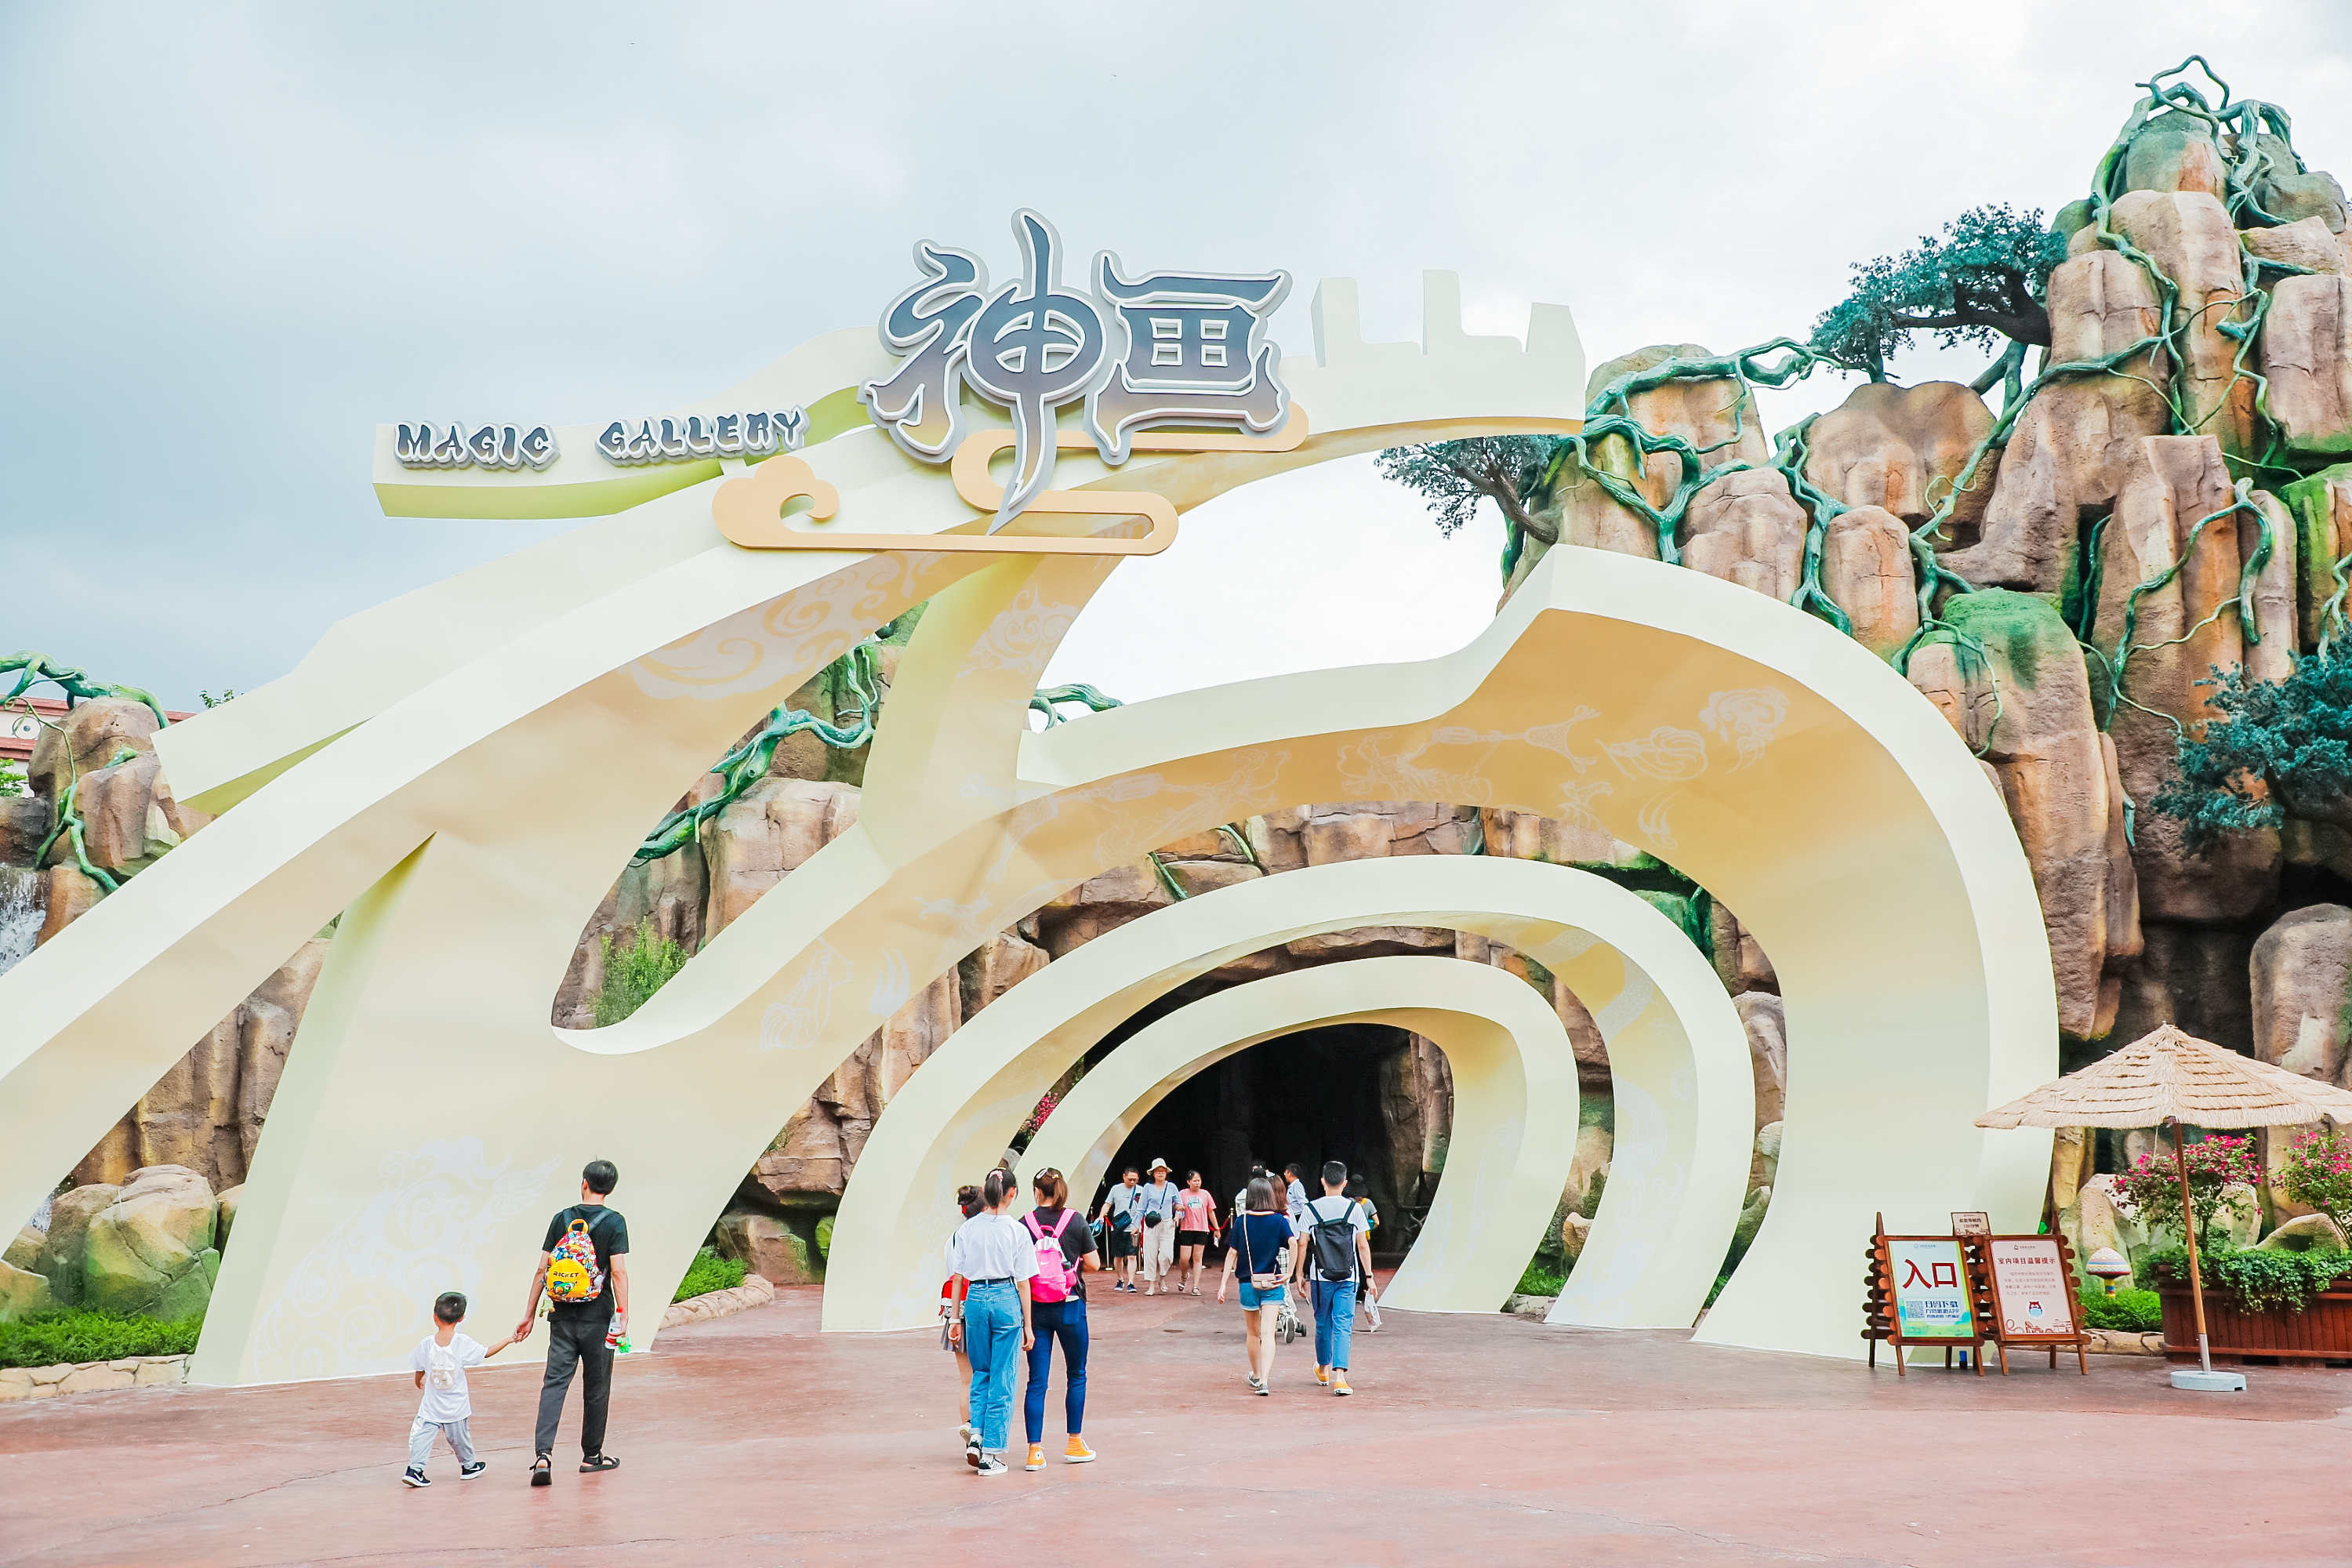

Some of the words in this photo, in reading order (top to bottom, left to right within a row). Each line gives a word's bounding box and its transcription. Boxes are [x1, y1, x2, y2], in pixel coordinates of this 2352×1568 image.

[863, 209, 1287, 514] 神画
[394, 419, 554, 468] MAGIC
[595, 406, 808, 463] GALLERY
[1901, 1258, 1958, 1290] 入口
